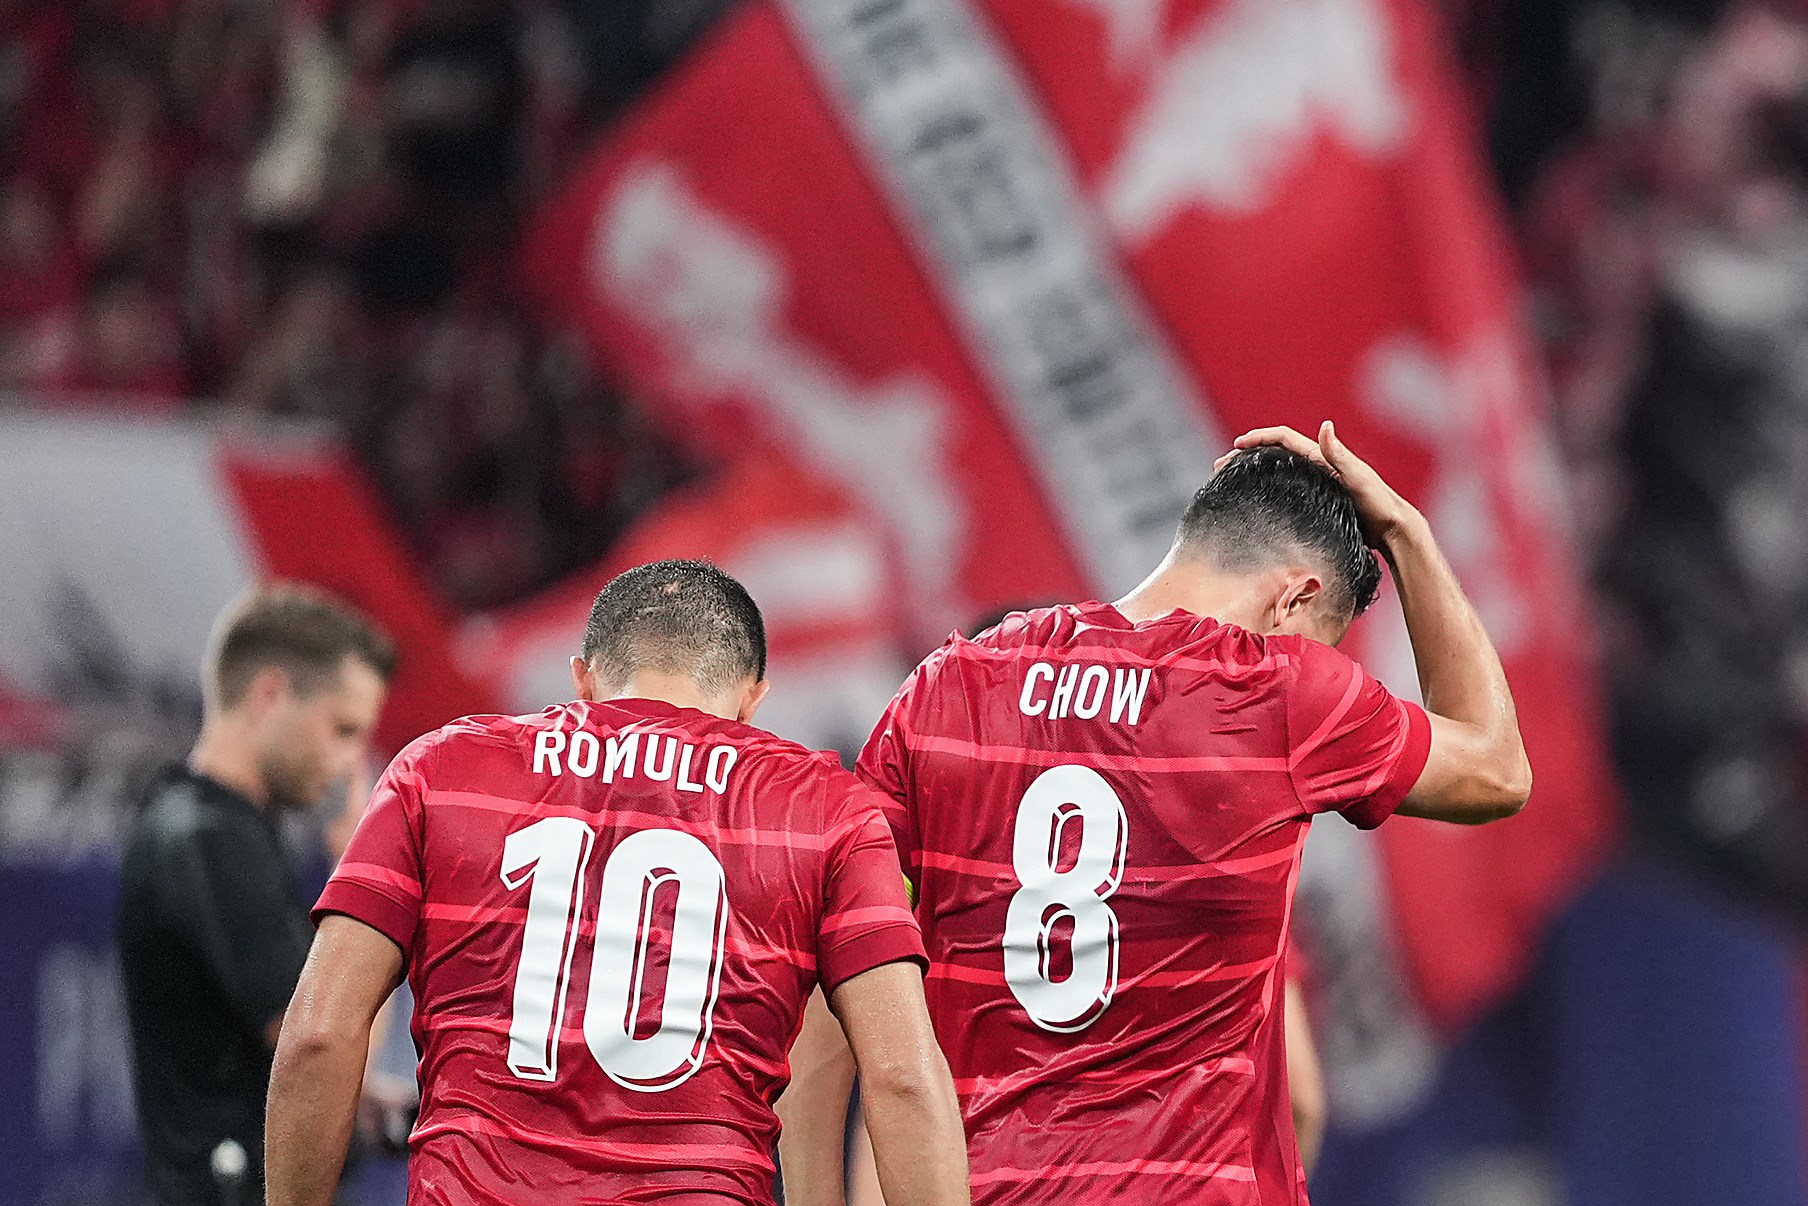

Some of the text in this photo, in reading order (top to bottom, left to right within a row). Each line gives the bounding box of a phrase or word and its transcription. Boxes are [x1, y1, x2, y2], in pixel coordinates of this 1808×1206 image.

[532, 730, 738, 795] ROMULO
[1019, 661, 1152, 726] CHOW
[500, 817, 727, 1093] 10
[1004, 764, 1128, 1033] 8
